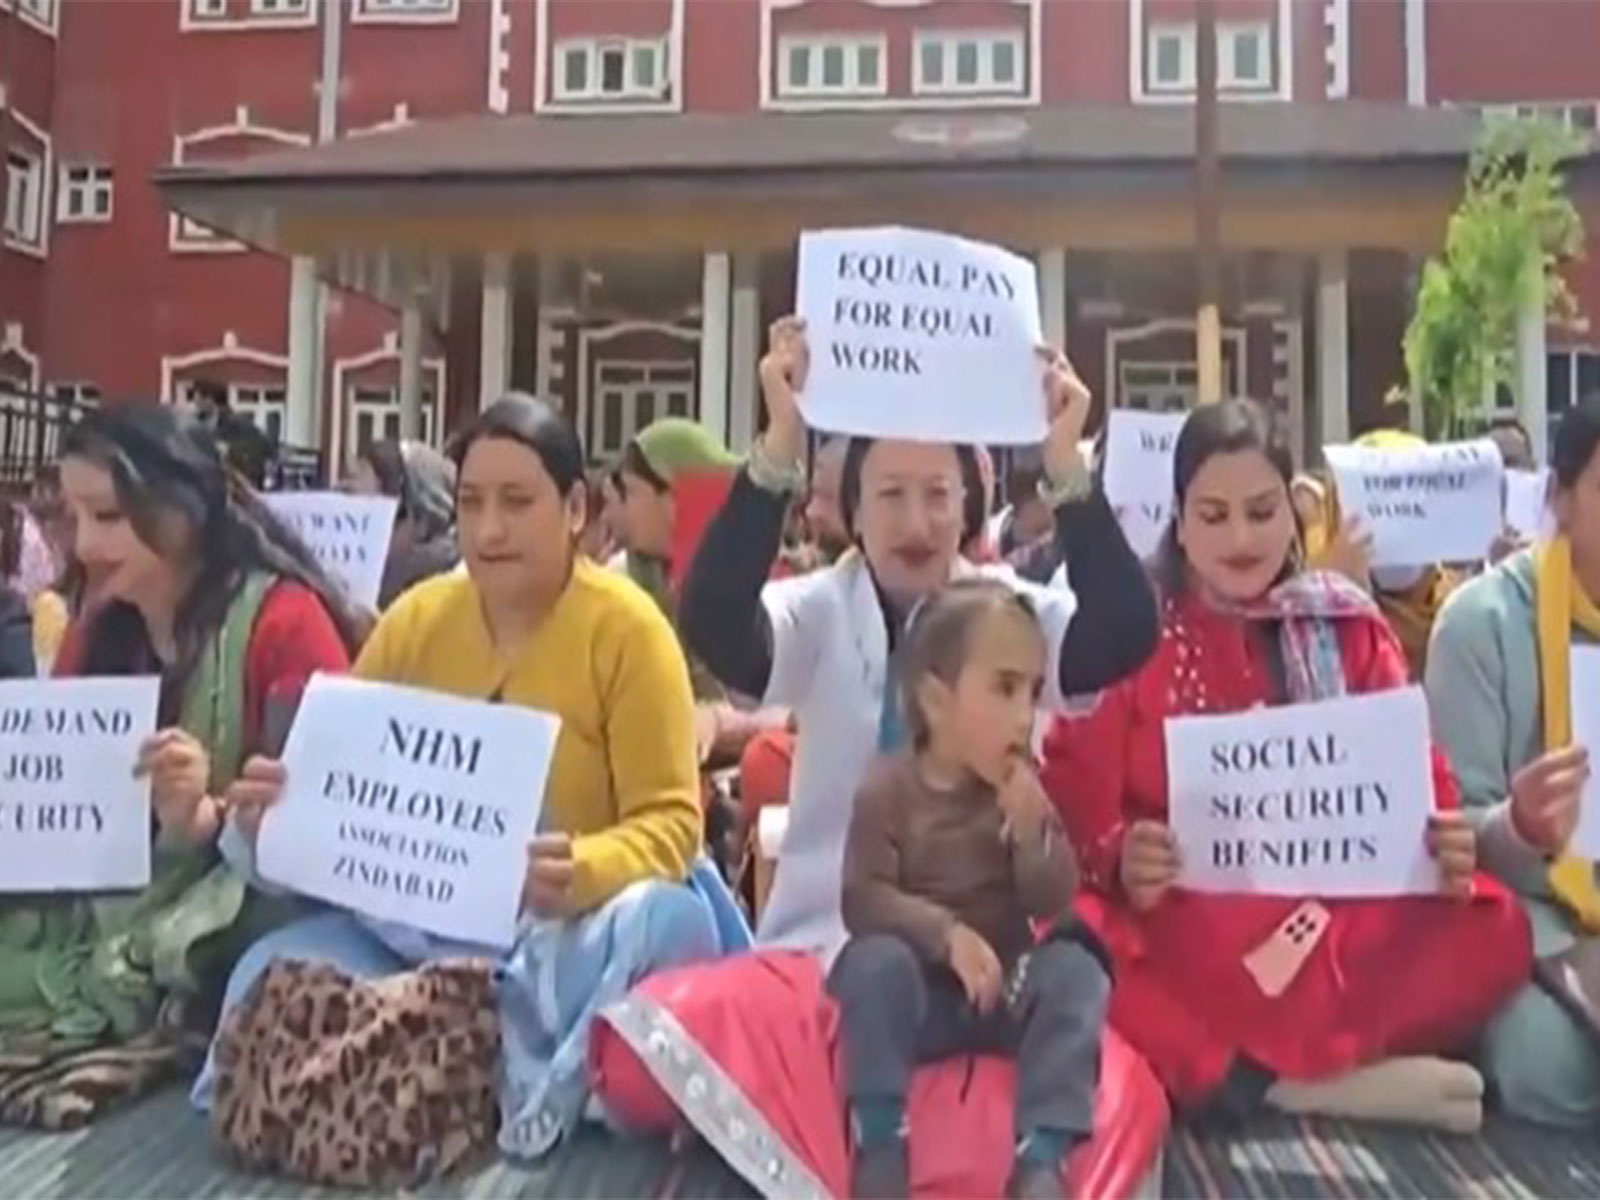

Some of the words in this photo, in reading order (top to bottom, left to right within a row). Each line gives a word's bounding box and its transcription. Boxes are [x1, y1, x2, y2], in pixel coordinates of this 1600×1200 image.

[837, 252, 950, 289] EQUAL
[961, 263, 1018, 300] PAY
[834, 298, 892, 328] FOR
[901, 303, 1000, 338] EQUAL
[830, 341, 923, 376] WORK
[0, 707, 133, 735] DEMAND
[381, 716, 483, 775] NHM
[1210, 733, 1348, 774] SOCIAL
[3, 753, 65, 782] JOB
[0, 802, 107, 832] URITY
[321, 769, 508, 837] EMPLOYEES
[1210, 781, 1392, 821] SECURITY
[336, 822, 471, 867] ASSOCIATION
[1212, 836, 1378, 868] BENIFITS
[332, 855, 456, 904] ZINDABAD
